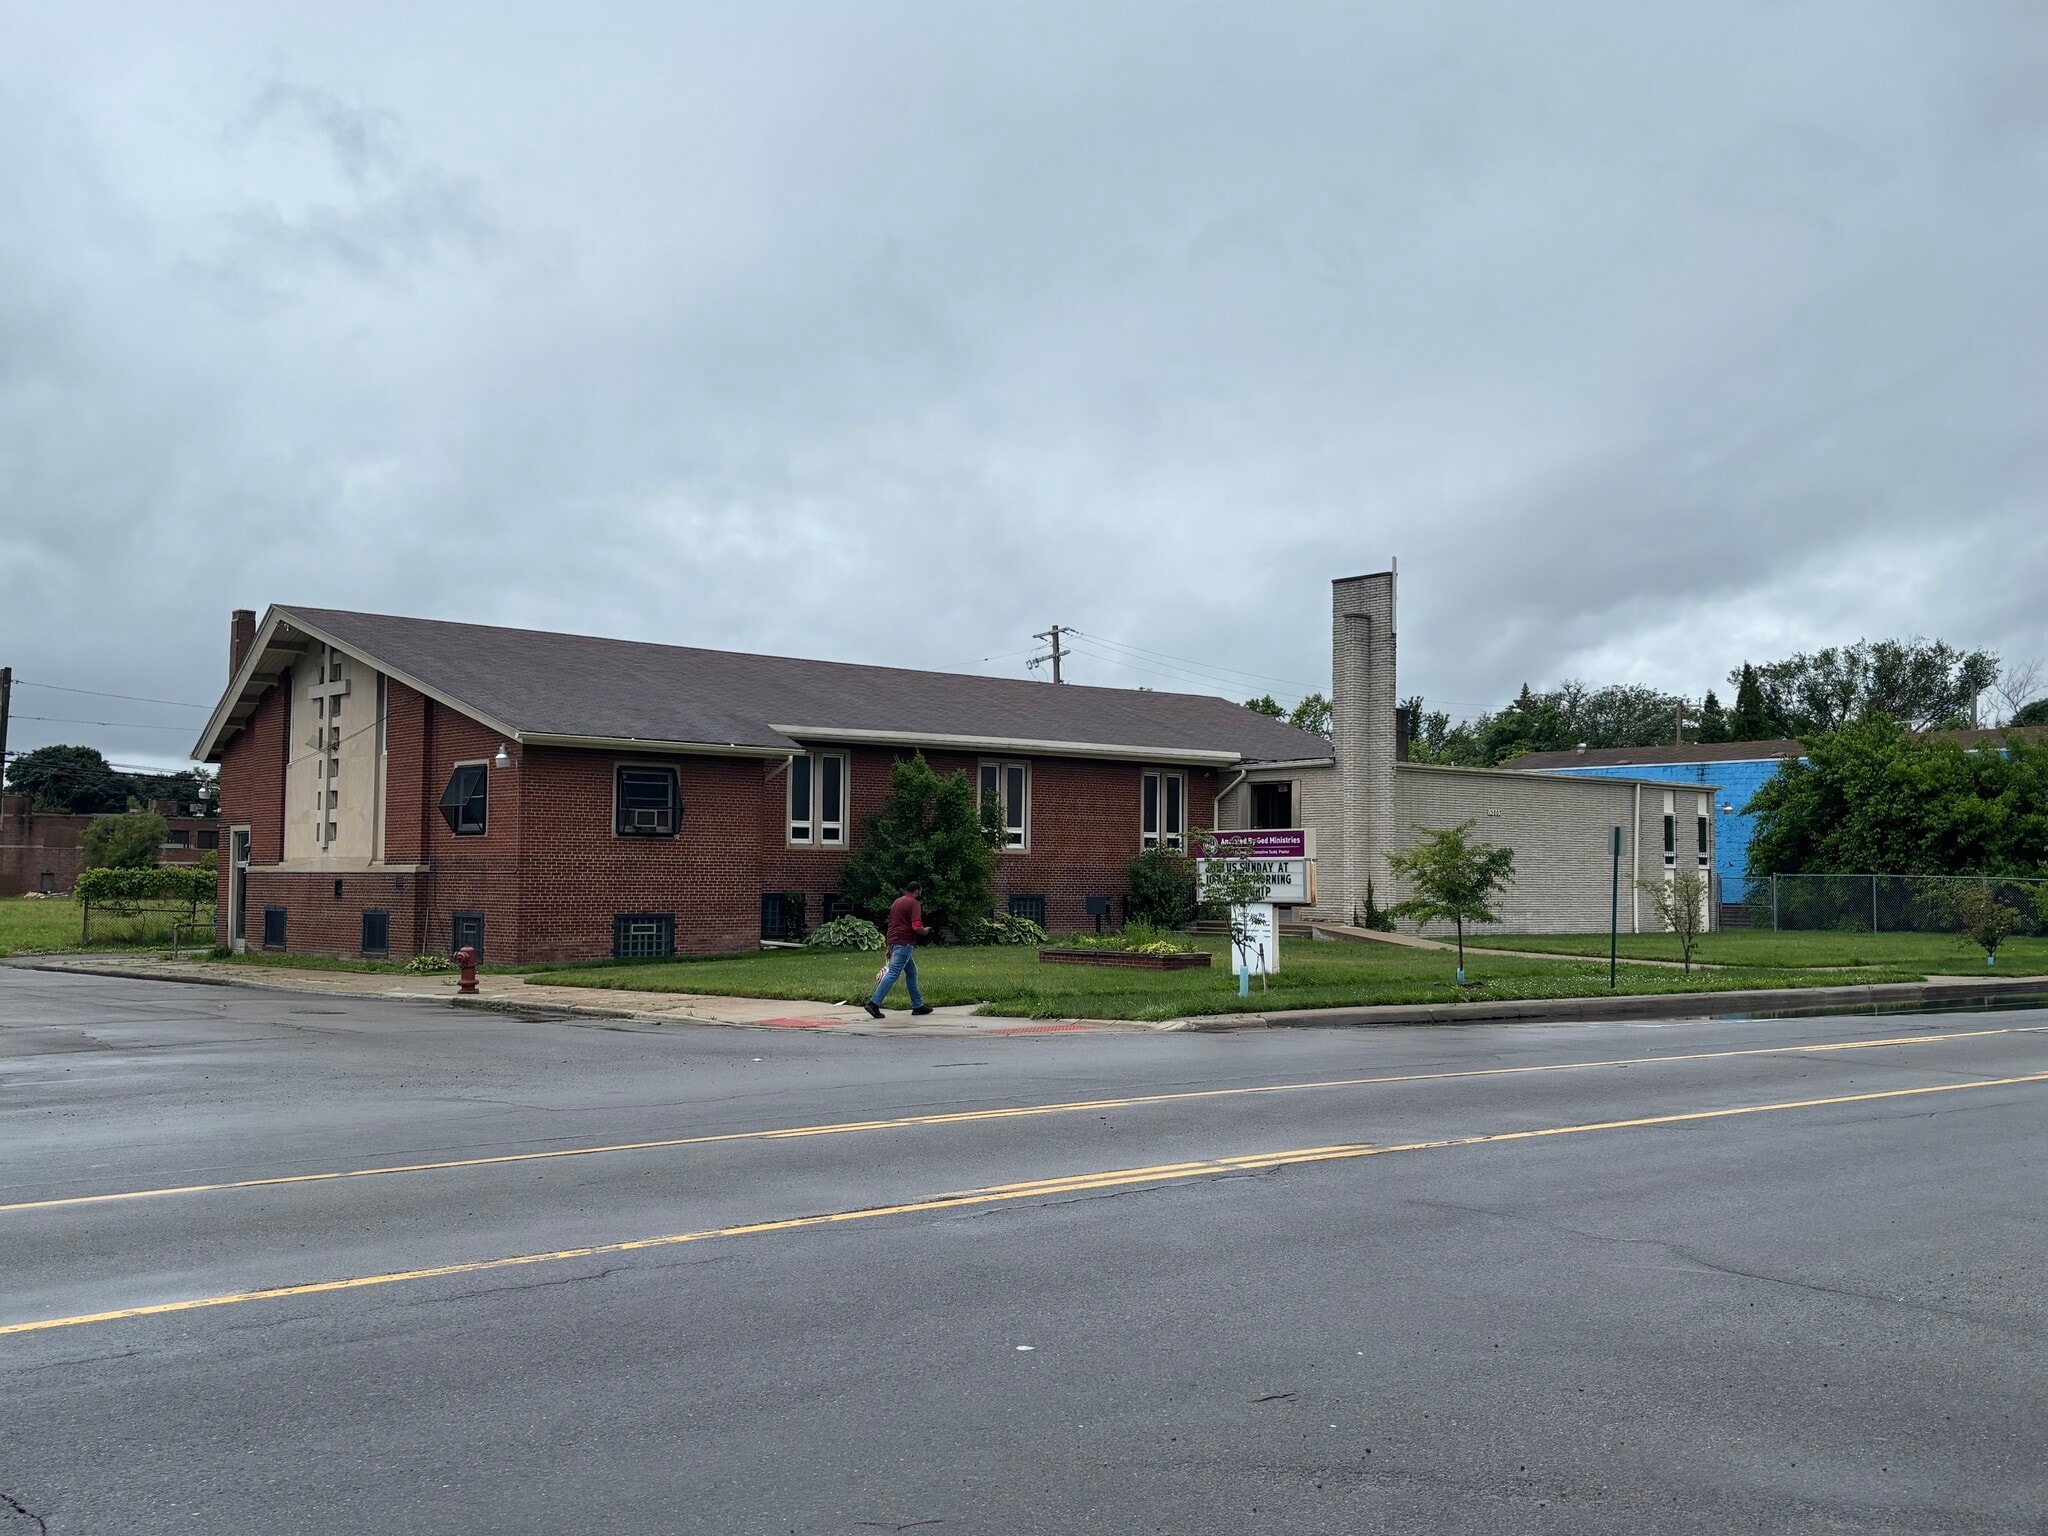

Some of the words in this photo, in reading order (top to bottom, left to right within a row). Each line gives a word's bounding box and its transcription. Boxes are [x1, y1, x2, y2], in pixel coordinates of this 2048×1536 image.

[1256, 837, 1269, 845] God
[1269, 835, 1301, 844] Ministries
[1226, 862, 1238, 872] US
[1240, 862, 1273, 873] SUNDAY
[1278, 862, 1289, 872] AT
